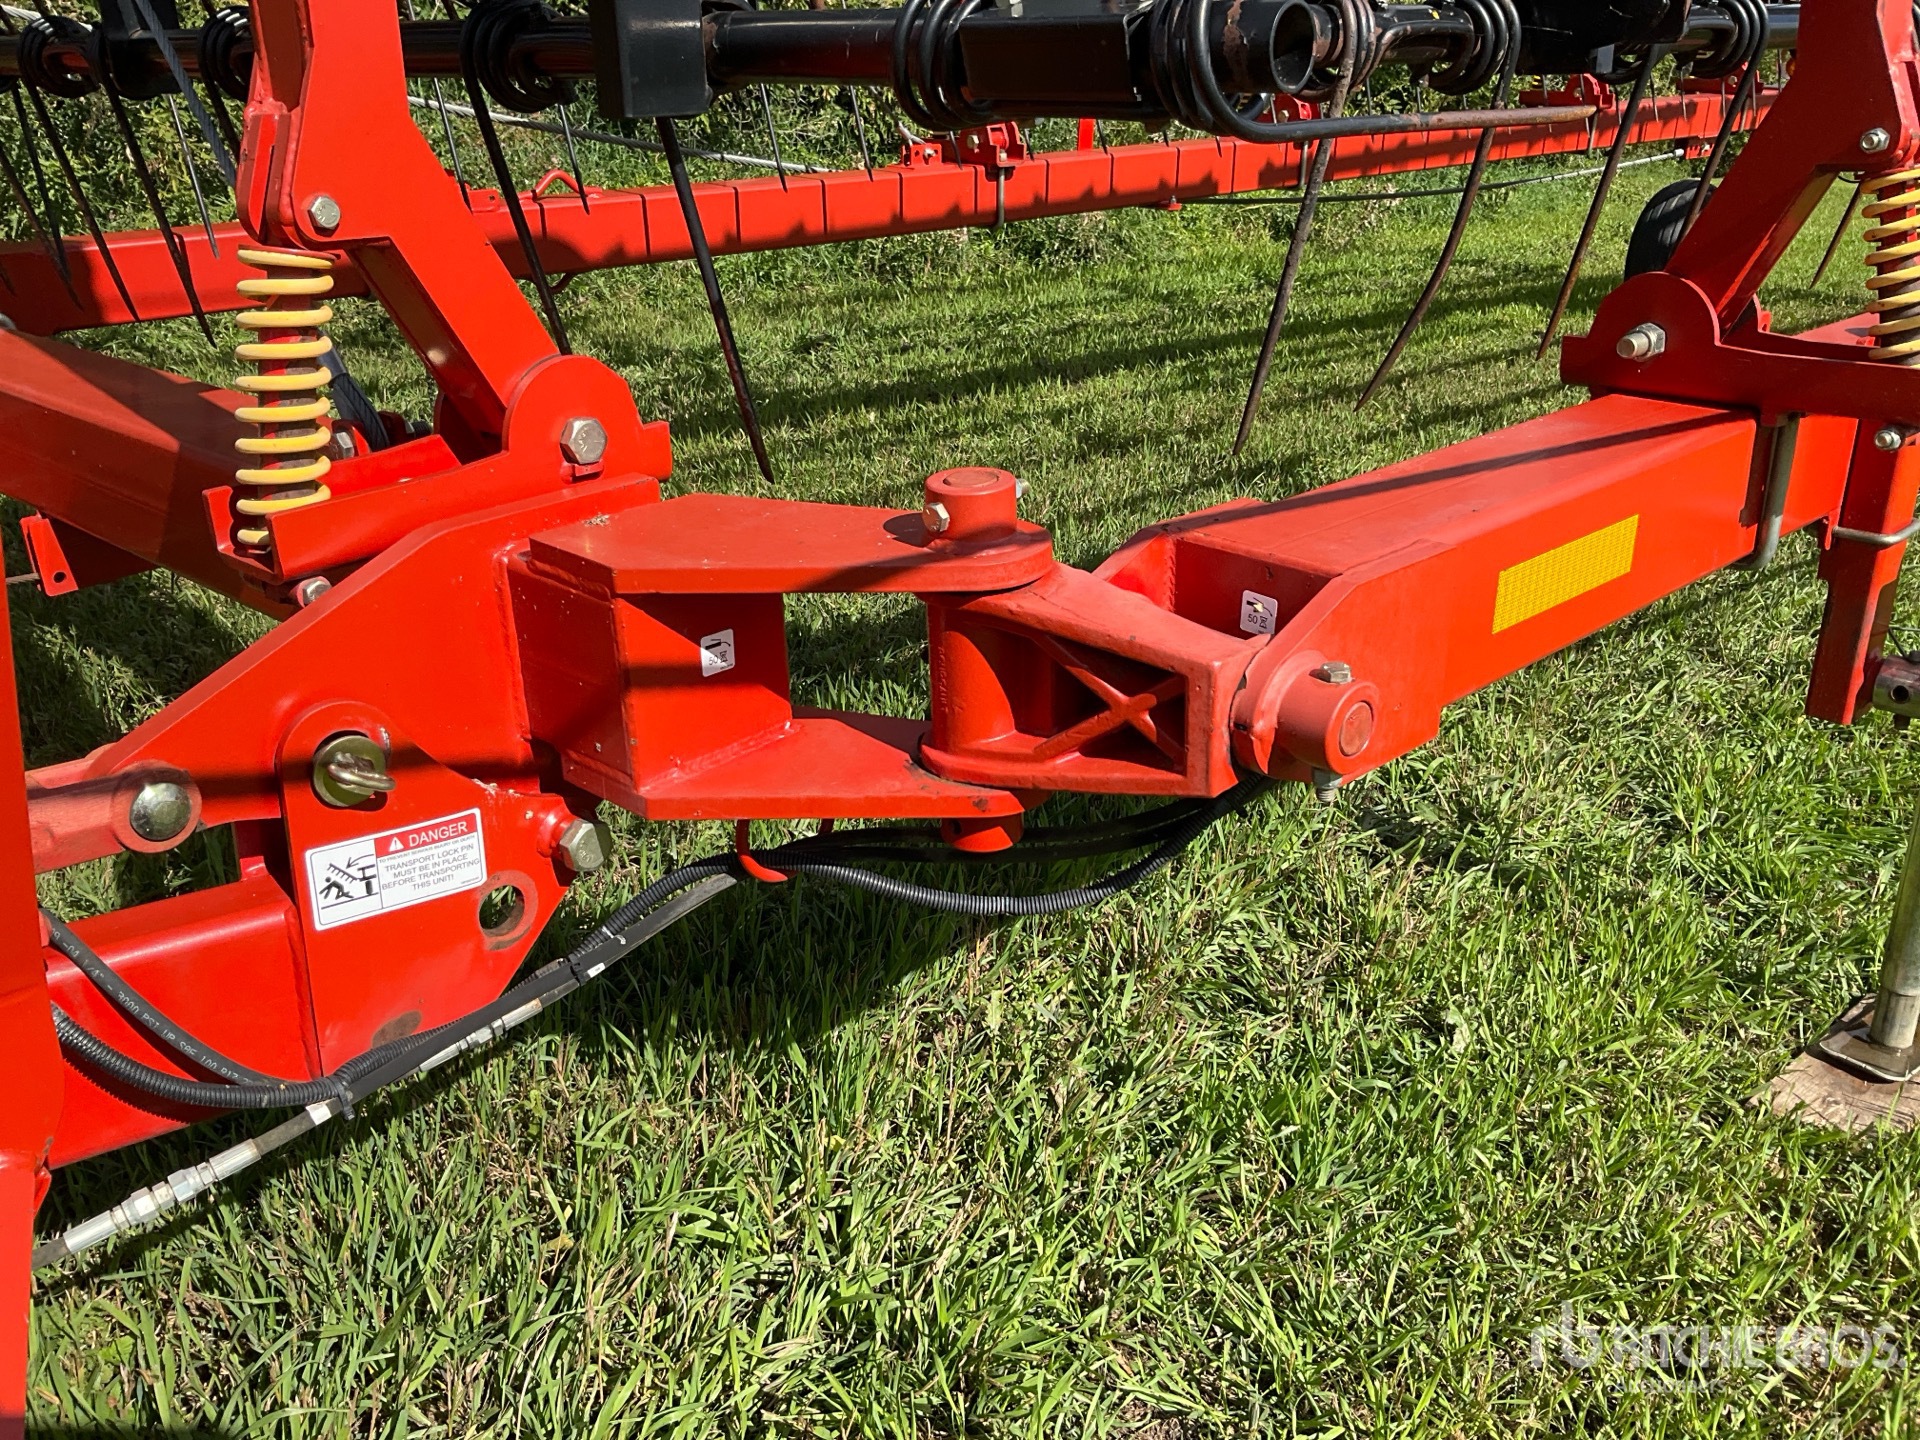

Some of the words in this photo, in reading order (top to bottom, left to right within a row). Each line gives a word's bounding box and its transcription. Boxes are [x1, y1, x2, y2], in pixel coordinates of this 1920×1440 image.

[1247, 614, 1258, 624] 50
[708, 654, 718, 666] 50
[408, 821, 469, 847] DANGER
[385, 853, 436, 872] TRANSPORT
[437, 847, 460, 859] LOCK
[460, 843, 474, 852] PIN
[393, 866, 417, 879] MUST
[418, 863, 431, 872] BE
[432, 860, 441, 869] IN
[442, 853, 468, 866] PLACE
[382, 876, 416, 891] BEFORE
[418, 858, 480, 880] TRANSPORTING
[412, 880, 432, 891] THIS
[433, 873, 454, 885] UNIT!
[118, 990, 140, 1014] 3000
[141, 1012, 160, 1028] PSI
[179, 1041, 199, 1056] SAE
[200, 1055, 218, 1070] 100
